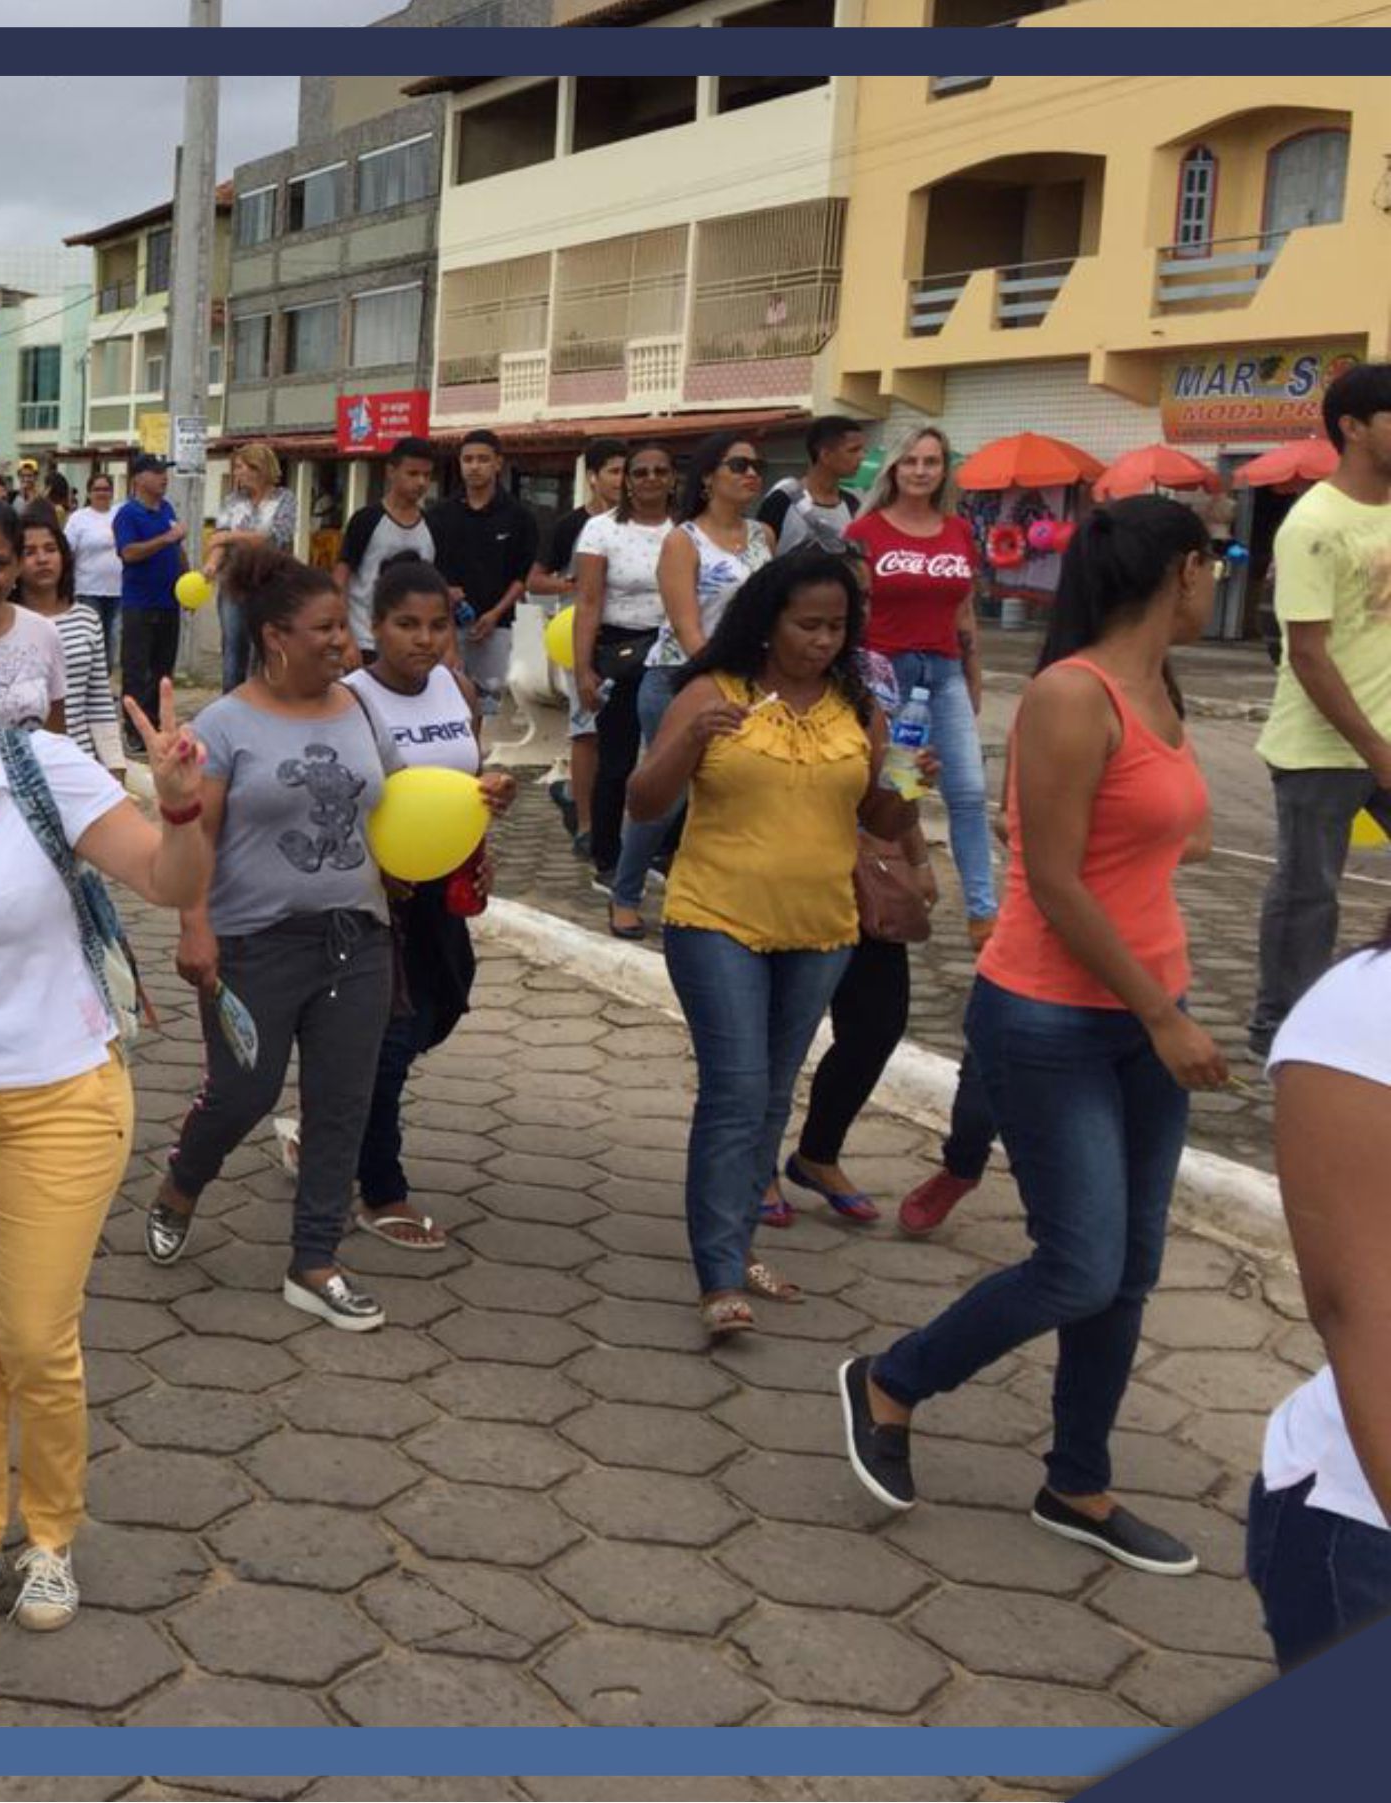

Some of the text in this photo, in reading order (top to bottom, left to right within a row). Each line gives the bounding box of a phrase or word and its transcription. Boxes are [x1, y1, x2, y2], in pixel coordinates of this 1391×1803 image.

[1174, 362, 1257, 397] MAR
[1183, 401, 1323, 422] MODA PR
